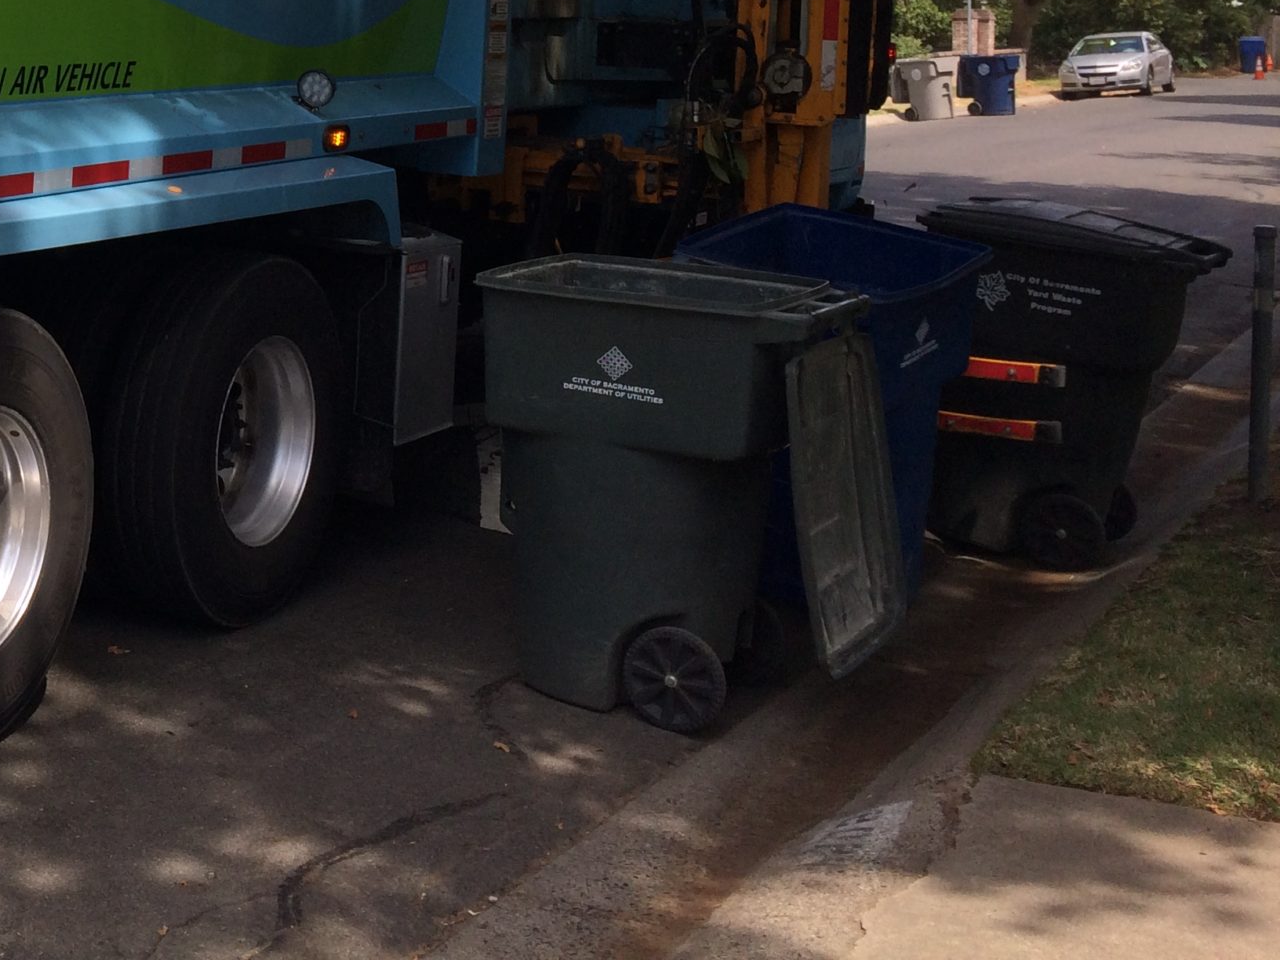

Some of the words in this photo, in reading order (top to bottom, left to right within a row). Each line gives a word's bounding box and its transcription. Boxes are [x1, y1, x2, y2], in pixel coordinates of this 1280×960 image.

[9, 64, 51, 97] AIR
[54, 60, 138, 93] VEHICLE
[1006, 272, 1026, 284] City
[1028, 276, 1040, 285] Of
[1042, 278, 1102, 296] Sacramento
[1027, 288, 1050, 299] Yard
[1051, 292, 1083, 305] Waste
[1030, 301, 1072, 316] Program
[563, 382, 614, 397] DEPARTMENT
[614, 390, 626, 398] OF
[627, 392, 665, 404] UTILITIES
[571, 376, 590, 386] CITY
[590, 379, 602, 387] OF
[603, 381, 656, 396] SACRAMENTO
